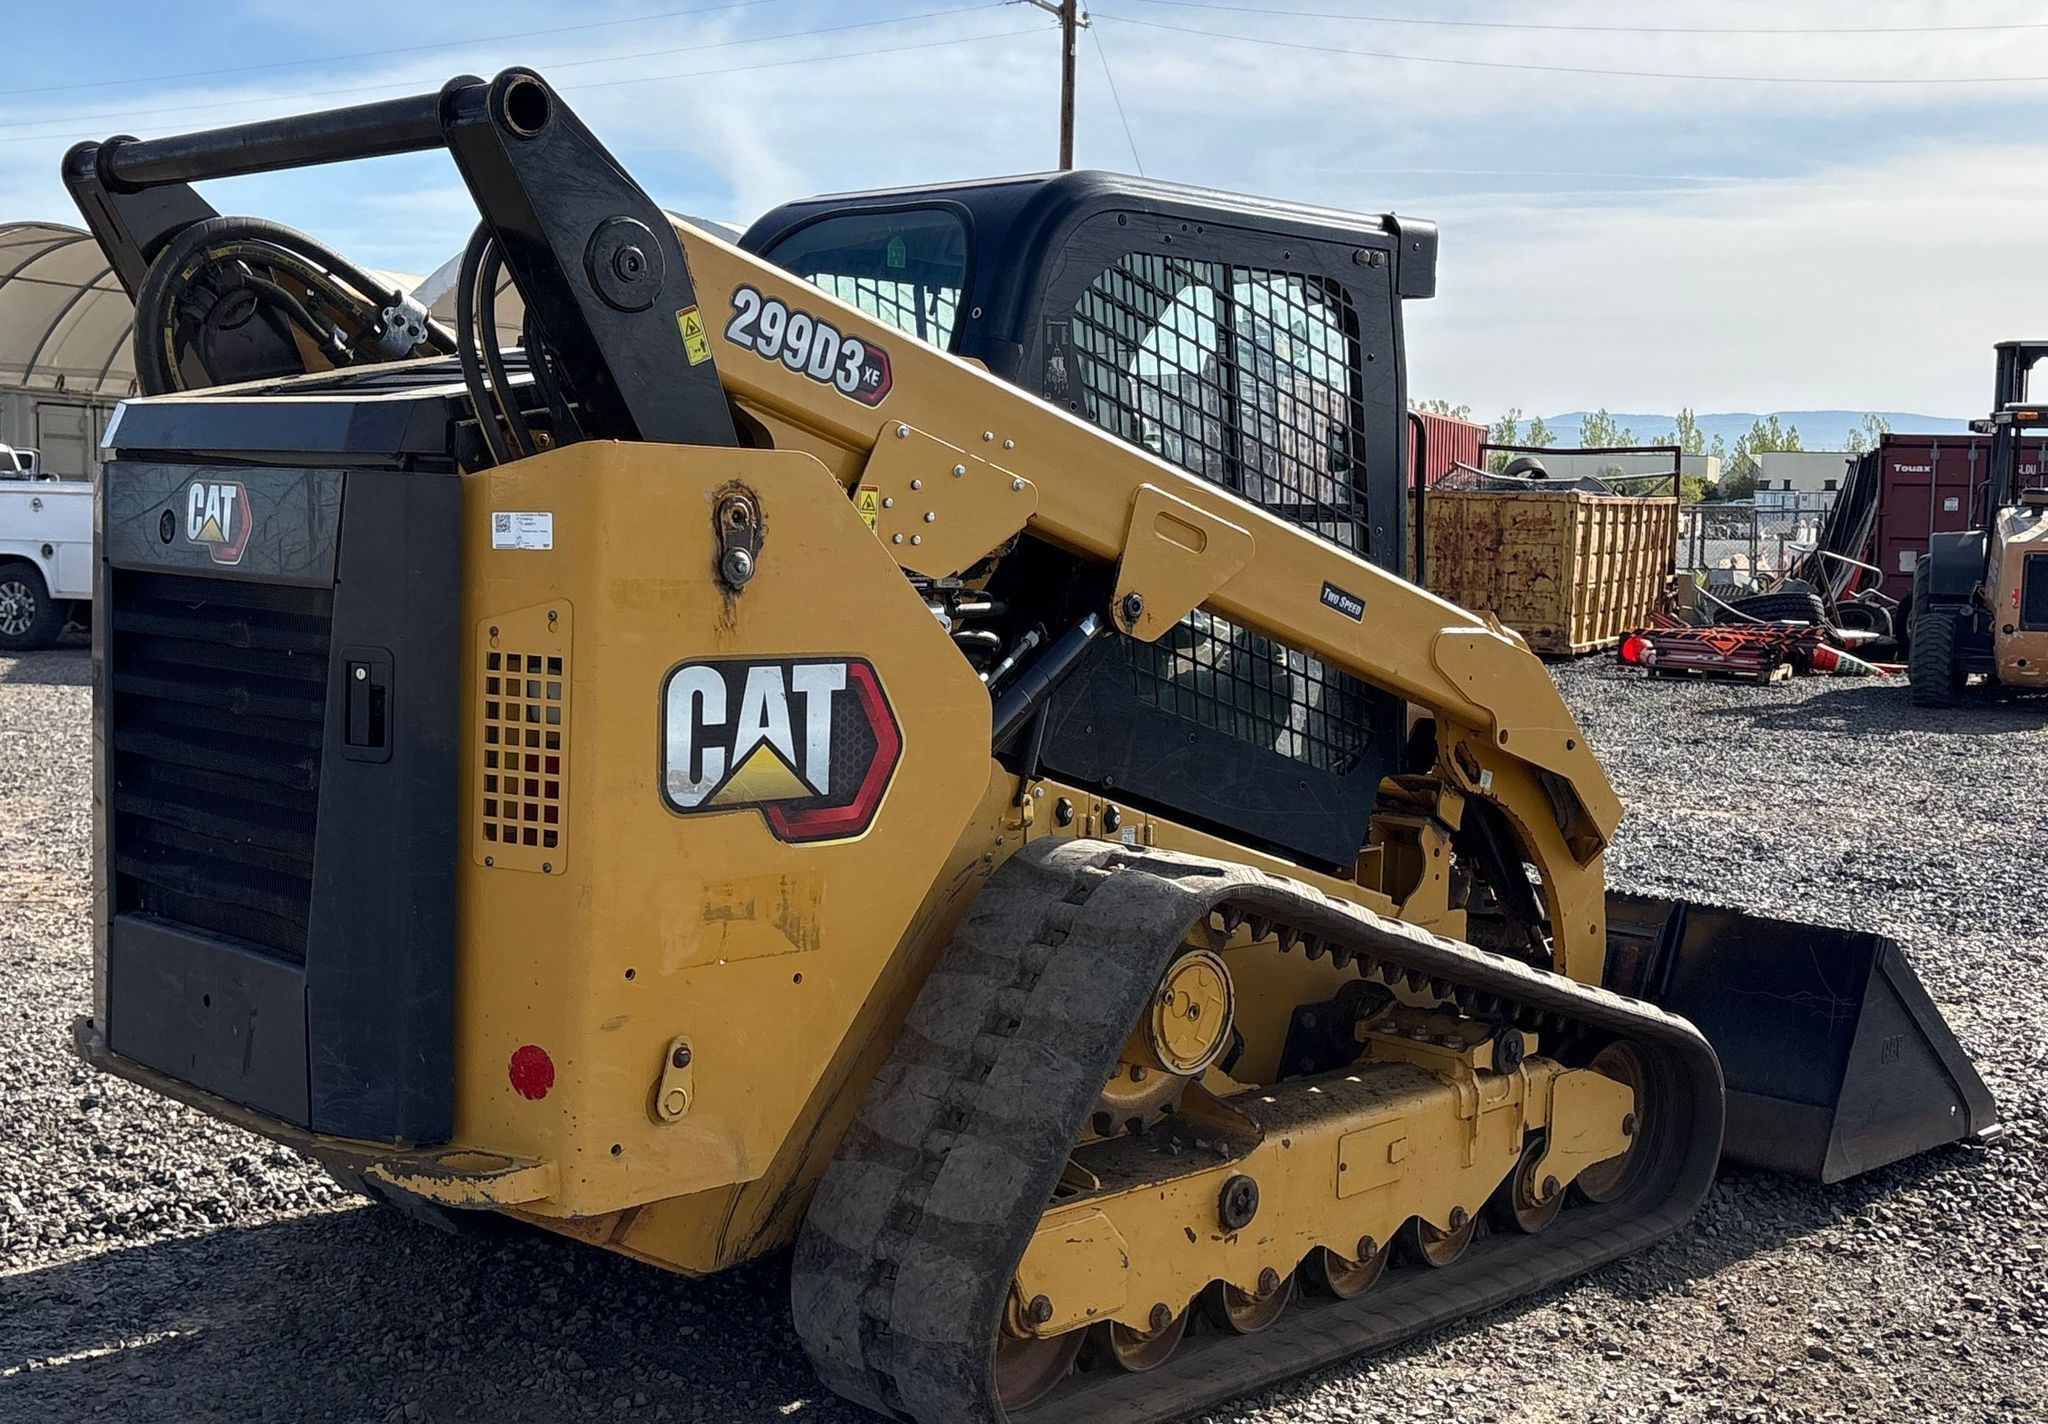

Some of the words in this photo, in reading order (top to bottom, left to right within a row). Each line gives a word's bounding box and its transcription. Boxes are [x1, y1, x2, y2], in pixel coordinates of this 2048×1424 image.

[727, 288, 865, 392] 299D3
[862, 365, 881, 387] XE
[1893, 463, 1931, 473] Touax
[187, 483, 237, 543] CAT
[666, 663, 847, 807] CAT
